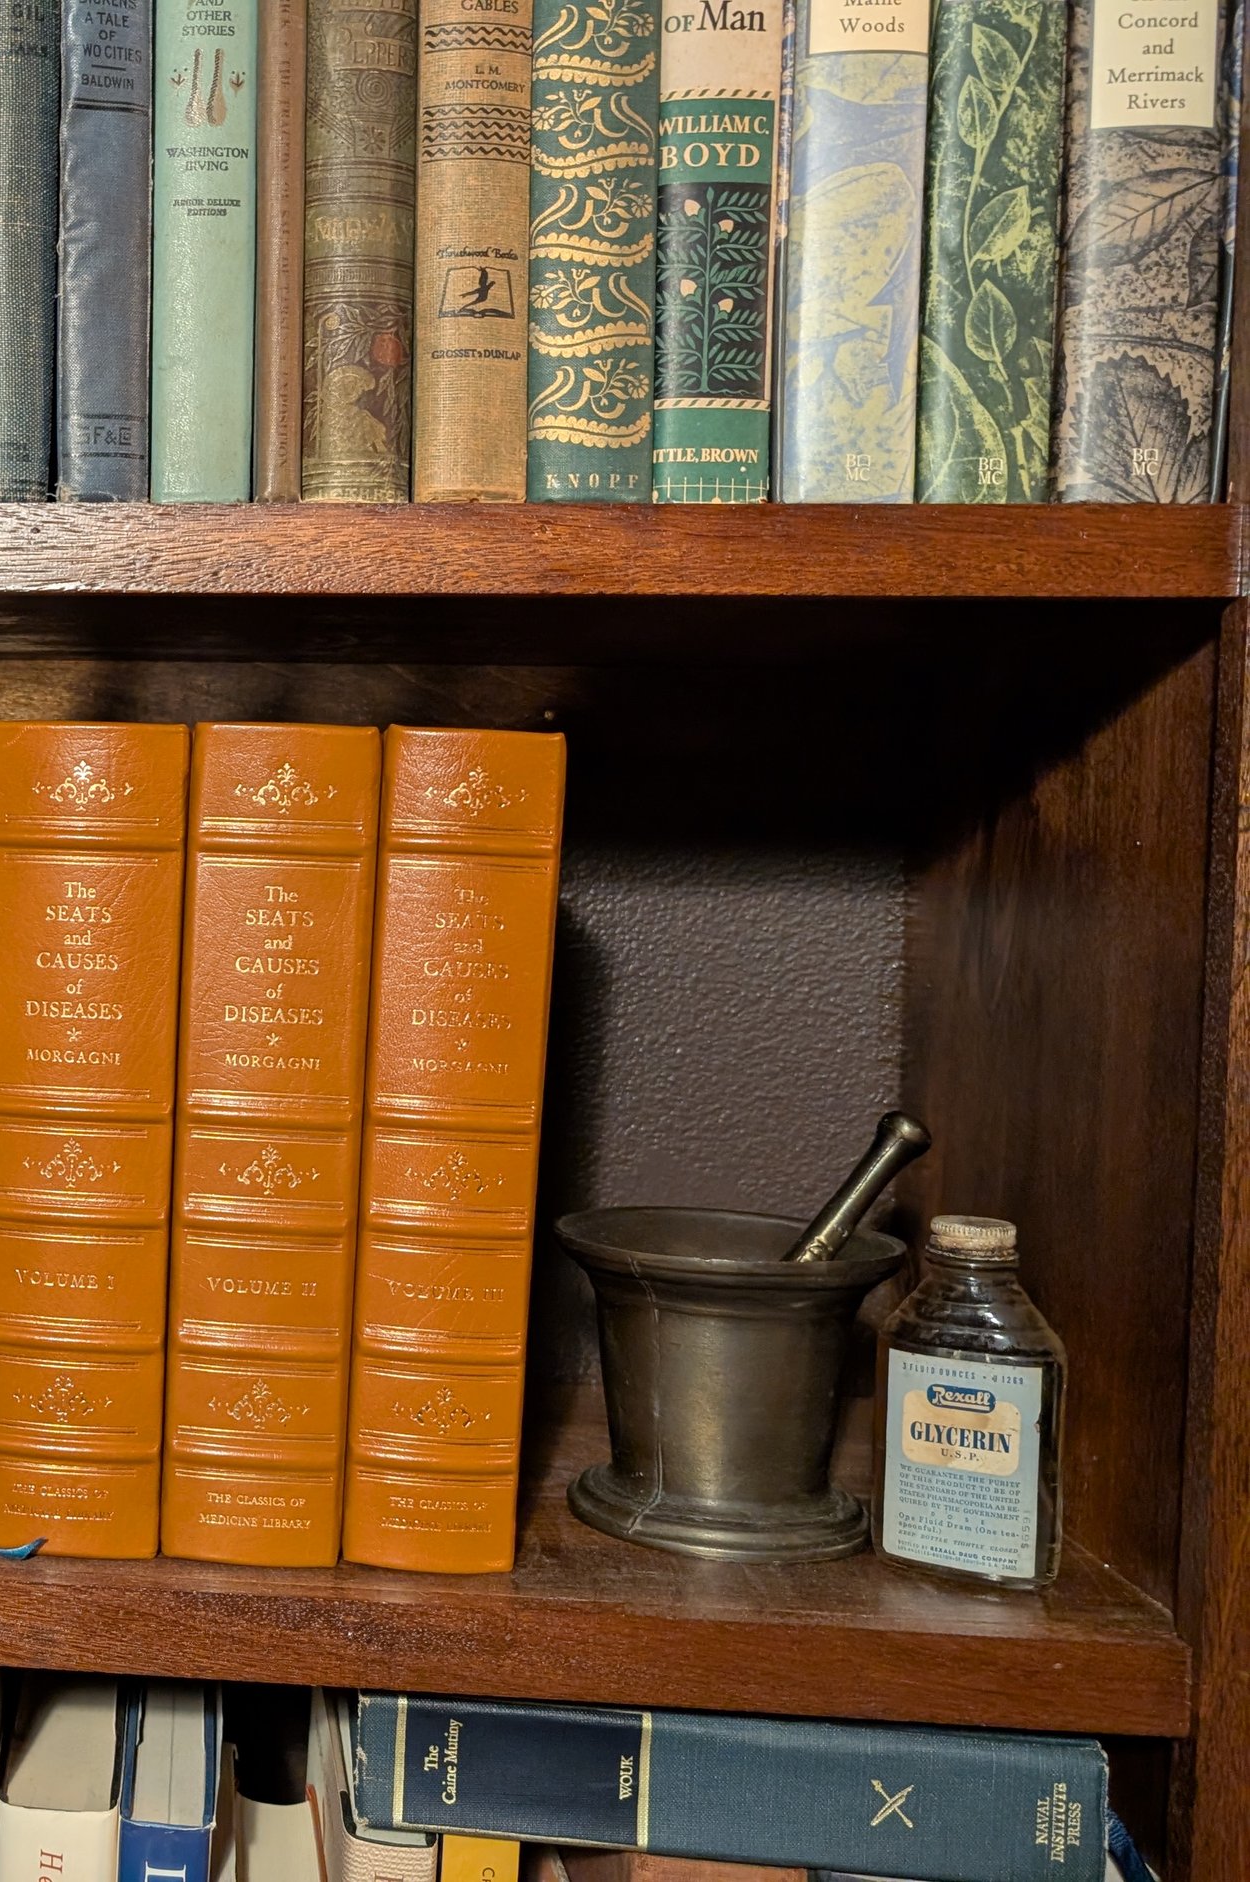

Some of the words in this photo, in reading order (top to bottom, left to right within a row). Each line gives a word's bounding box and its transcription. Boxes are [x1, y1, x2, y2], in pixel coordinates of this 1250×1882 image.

[84, 12, 94, 23] A
[96, 12, 130, 28] TALE
[186, 10, 232, 22] OTHER
[664, 15, 695, 33] OF
[697, 0, 767, 32] Man
[839, 17, 905, 33] Woods
[1118, 12, 1199, 29] Concord
[182, 26, 235, 37] STORIES
[104, 44, 142, 63] CITIES
[1142, 38, 1175, 55] and
[81, 73, 135, 90] BALDWIN
[1107, 66, 1204, 84] Merrimack
[444, 79, 526, 93] MONTGOMERY
[1126, 93, 1186, 110] Rivers
[659, 115, 749, 136] WILLIAM
[754, 115, 770, 135] C.
[166, 148, 249, 159] WASHINGTON
[659, 142, 761, 170] BOYD
[185, 160, 229, 172] IRVING
[546, 473, 639, 489] KNOPF
[64, 881, 97, 900] The
[264, 885, 299, 903] The
[45, 905, 112, 924] SEATS
[245, 909, 314, 928] SEATS
[64, 931, 92, 947] and
[264, 935, 293, 951] and
[36, 952, 119, 971] CAUSES
[234, 956, 320, 976] CAUSES
[66, 978, 85, 995] of
[265, 982, 285, 1000] of
[24, 1000, 124, 1020] DISEASES
[224, 1005, 324, 1025] DISEASES
[26, 1048, 122, 1066] MORGAGNI
[225, 1054, 322, 1071] MORGAGNI
[207, 1276, 293, 1297] VOLUME
[301, 1281, 318, 1297] II
[909, 1363, 935, 1374] FLUID
[939, 1368, 975, 1380] OUNCES
[1001, 1376, 1024, 1385] 1269
[932, 1386, 991, 1407] Rexall
[910, 1420, 1012, 1453] GLYCERIN
[941, 1448, 980, 1462] U.S.P.
[900, 1464, 912, 1472] WE
[915, 1467, 964, 1480] GUARANTEE
[968, 1476, 985, 1484] THE
[989, 1479, 1021, 1488] PURITY
[912, 1474, 932, 1484] THIS
[936, 1477, 976, 1490] PRODUCT
[899, 1480, 913, 1488] THE
[916, 1483, 957, 1495] STANDARD
[989, 1495, 1020, 1504] UNITED
[444, 1718, 463, 1765] Mutiny
[424, 1744, 440, 1772] The
[441, 1766, 459, 1805] Caine
[618, 1754, 635, 1800] WOUK
[1035, 1796, 1051, 1845] NAVAL
[1051, 1782, 1067, 1863] INSTITUTE
[1066, 1802, 1082, 1846] PRESS
